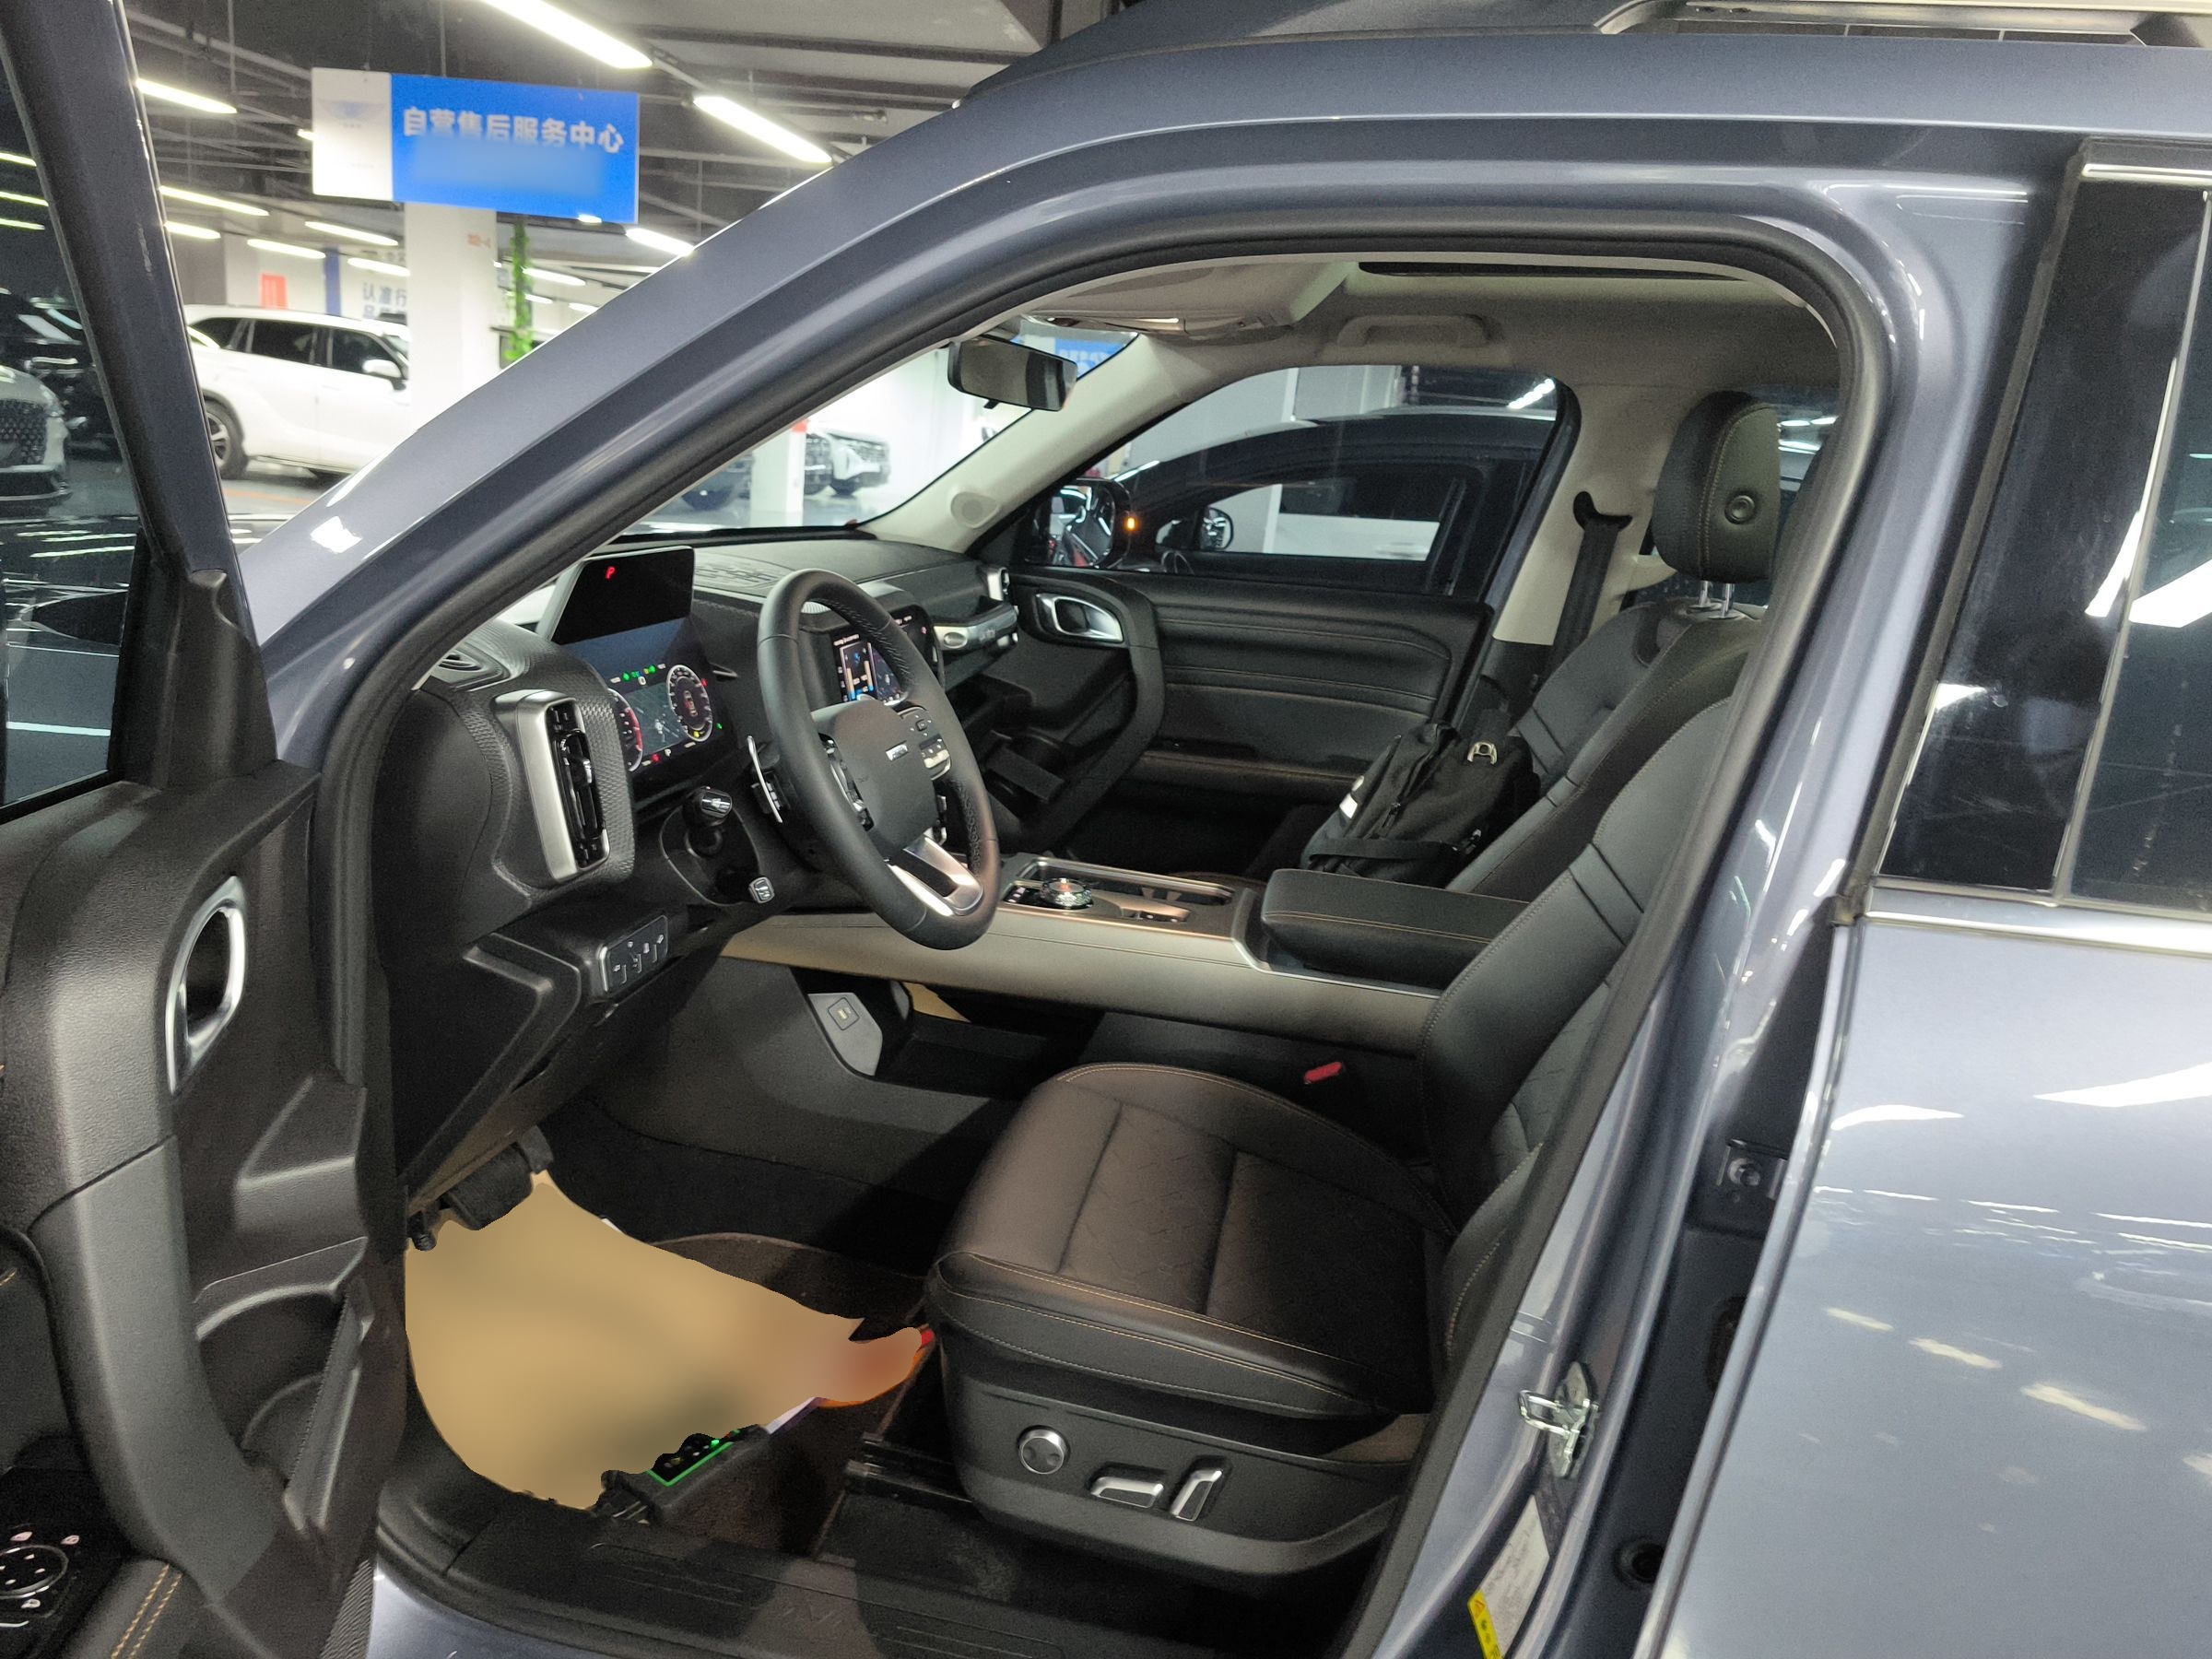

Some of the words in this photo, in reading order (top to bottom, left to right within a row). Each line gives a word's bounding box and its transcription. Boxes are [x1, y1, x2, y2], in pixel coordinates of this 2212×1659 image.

[404, 106, 625, 154] 自营售后服务中心
[606, 566, 616, 579] P
